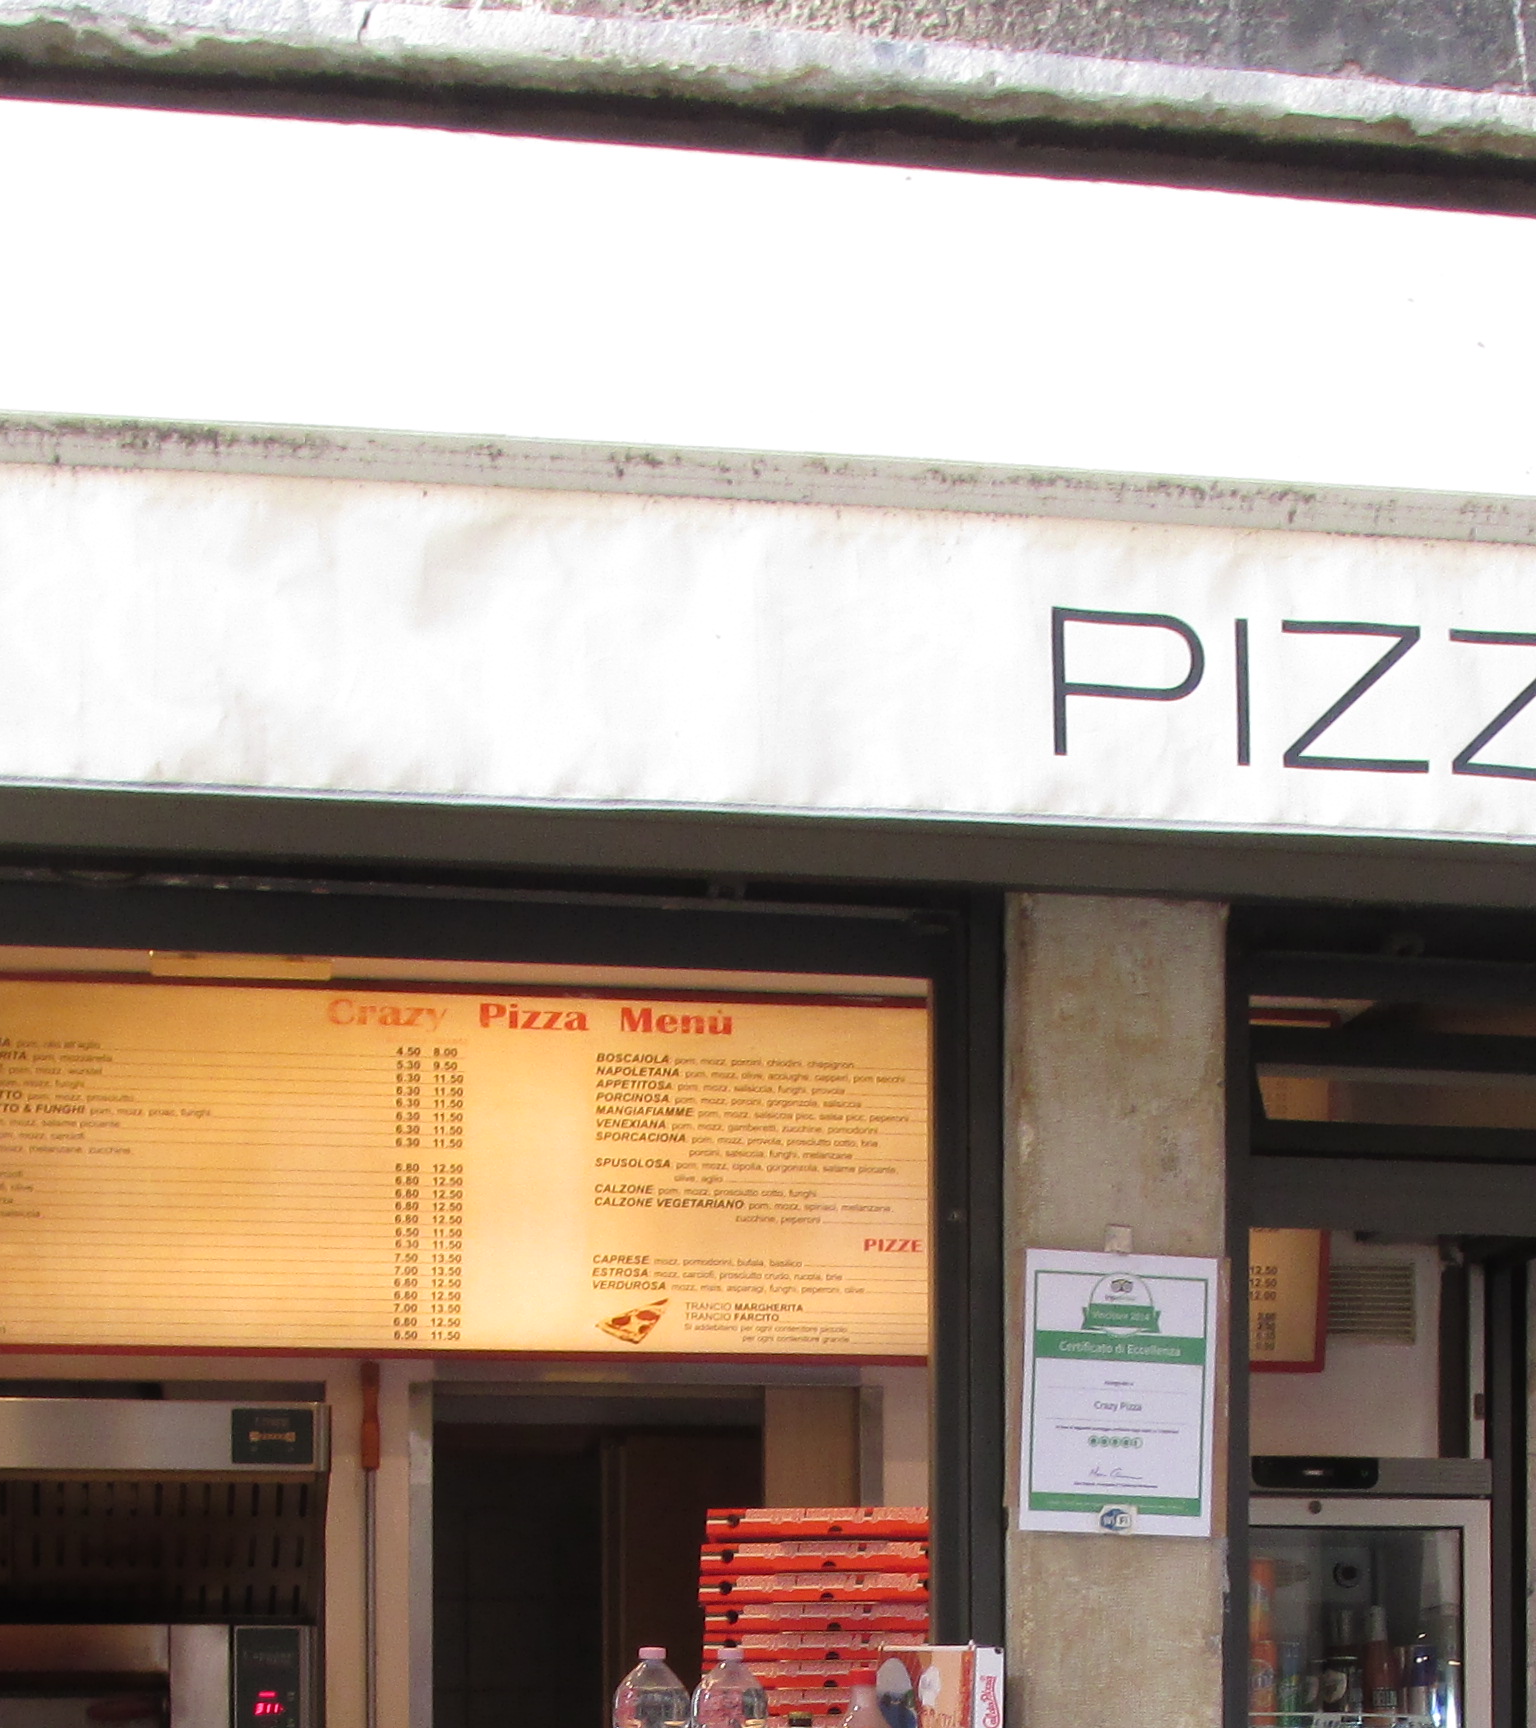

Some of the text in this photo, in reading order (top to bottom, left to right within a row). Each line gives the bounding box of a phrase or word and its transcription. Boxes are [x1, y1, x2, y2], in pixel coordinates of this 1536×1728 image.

[327, 999, 448, 1032] Crazy
[479, 1003, 589, 1031] Pizza
[596, 1052, 669, 1063] BOSCAIOLA
[596, 1066, 680, 1077] NAPOLETANA
[596, 1079, 673, 1090] APPETITOSA
[596, 1092, 669, 1103] PORCINOSA
[35, 1104, 85, 1114] FUNGHI
[595, 1105, 694, 1117] MANGIAFIAMME
[596, 1118, 666, 1129] VENEXIANA
[595, 1131, 686, 1142] SPORCACIONA
[595, 1157, 670, 1168] SPUSOLOSA
[594, 1184, 654, 1194] CALZONE
[594, 1197, 653, 1207] CALZONE
[656, 1198, 745, 1209] VEGETARIANO
[864, 1238, 924, 1252] PIZZE
[592, 1254, 650, 1265] CAPRESE
[592, 1267, 649, 1277] ESTROSA
[592, 1280, 666, 1290] VERDUROSA
[685, 1302, 803, 1312] TRANCIO MARGHERITA
[685, 1312, 779, 1322] TRANCIO FARCITO
[1058, 1341, 1113, 1354] Certificato
[1115, 1343, 1125, 1353] di
[1093, 1400, 1142, 1412] Crazy Pizza
